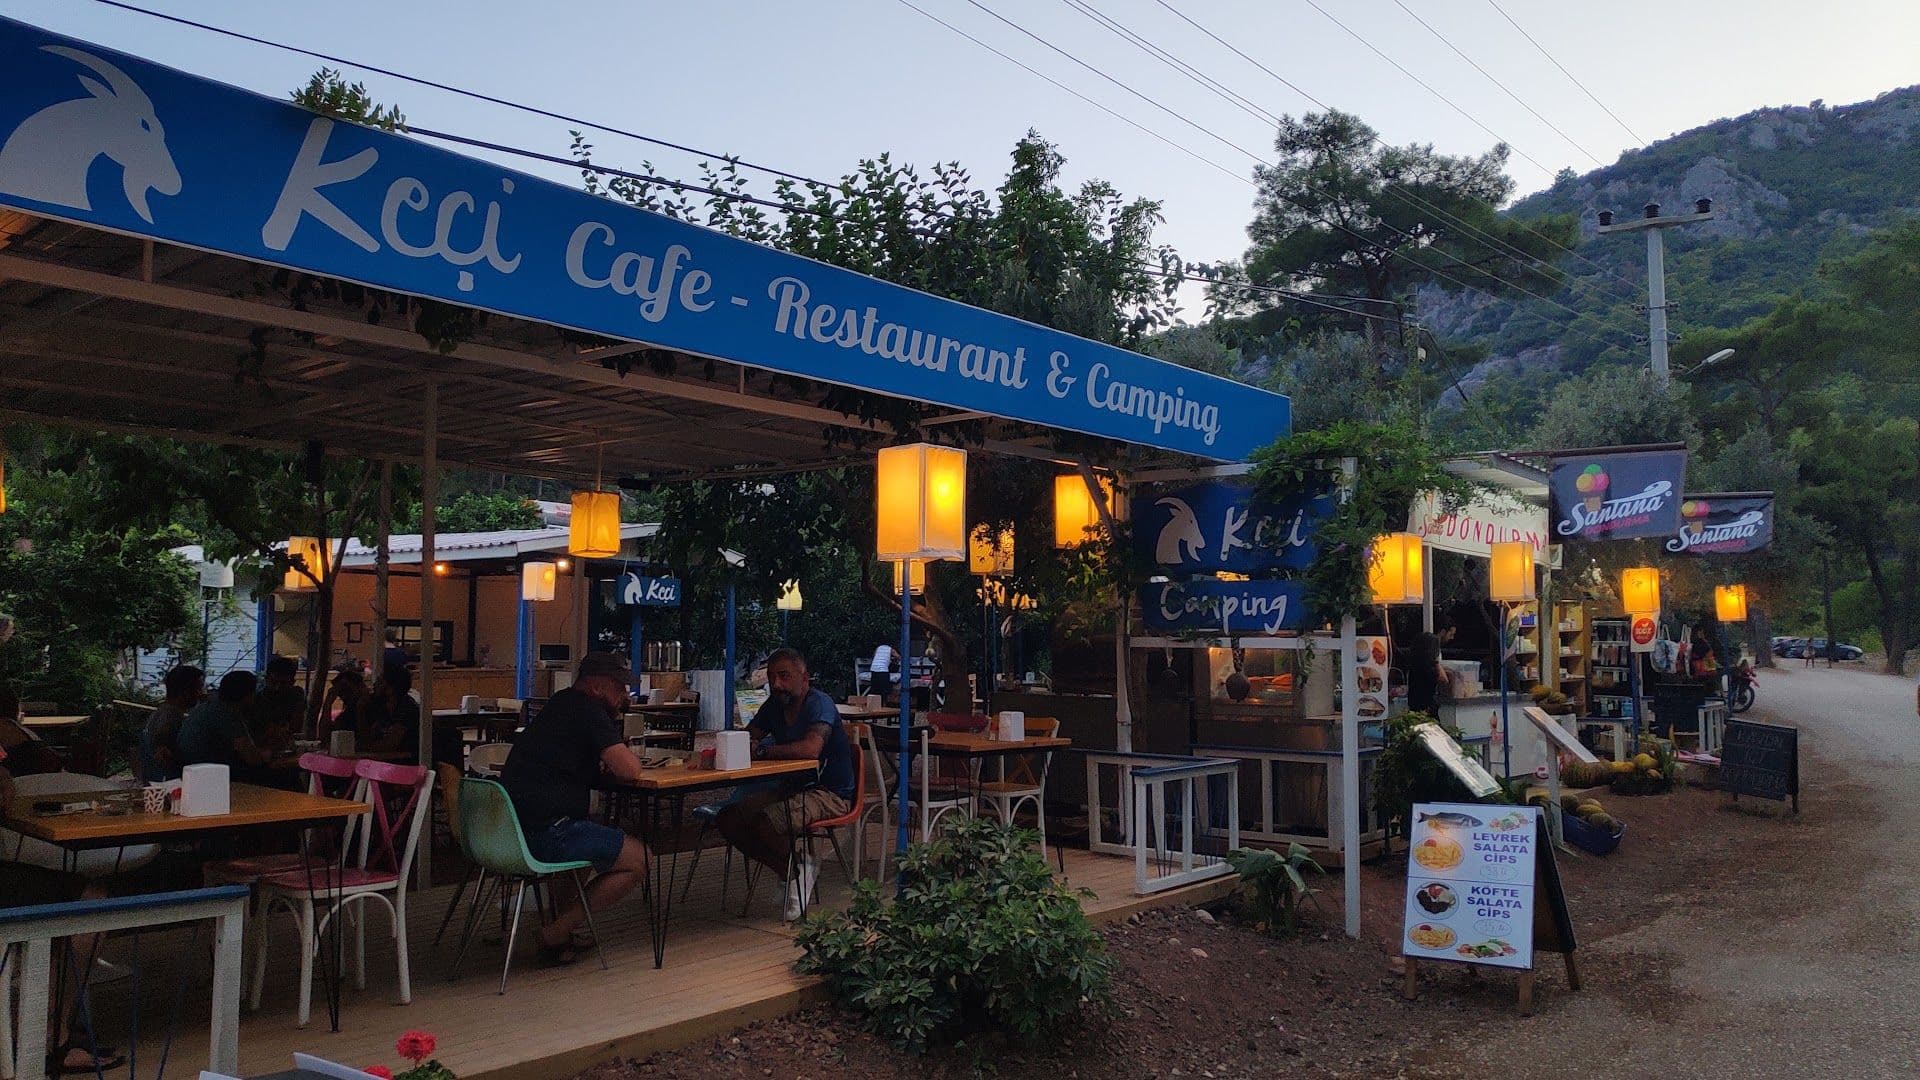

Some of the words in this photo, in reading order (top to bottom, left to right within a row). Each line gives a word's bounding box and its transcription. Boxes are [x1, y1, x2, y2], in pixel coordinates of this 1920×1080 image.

[262, 117, 522, 292] Keçi
[566, 222, 715, 322] Cafe
[768, 276, 1029, 391] Restaurant
[1046, 351, 1077, 399] &
[1086, 363, 1221, 446] Camping
[1557, 480, 1672, 536] Santana
[1666, 511, 1764, 552] Santana
[1473, 832, 1530, 843] LEVREK
[1473, 843, 1528, 854] SALATA
[1466, 896, 1522, 909] SALATA
